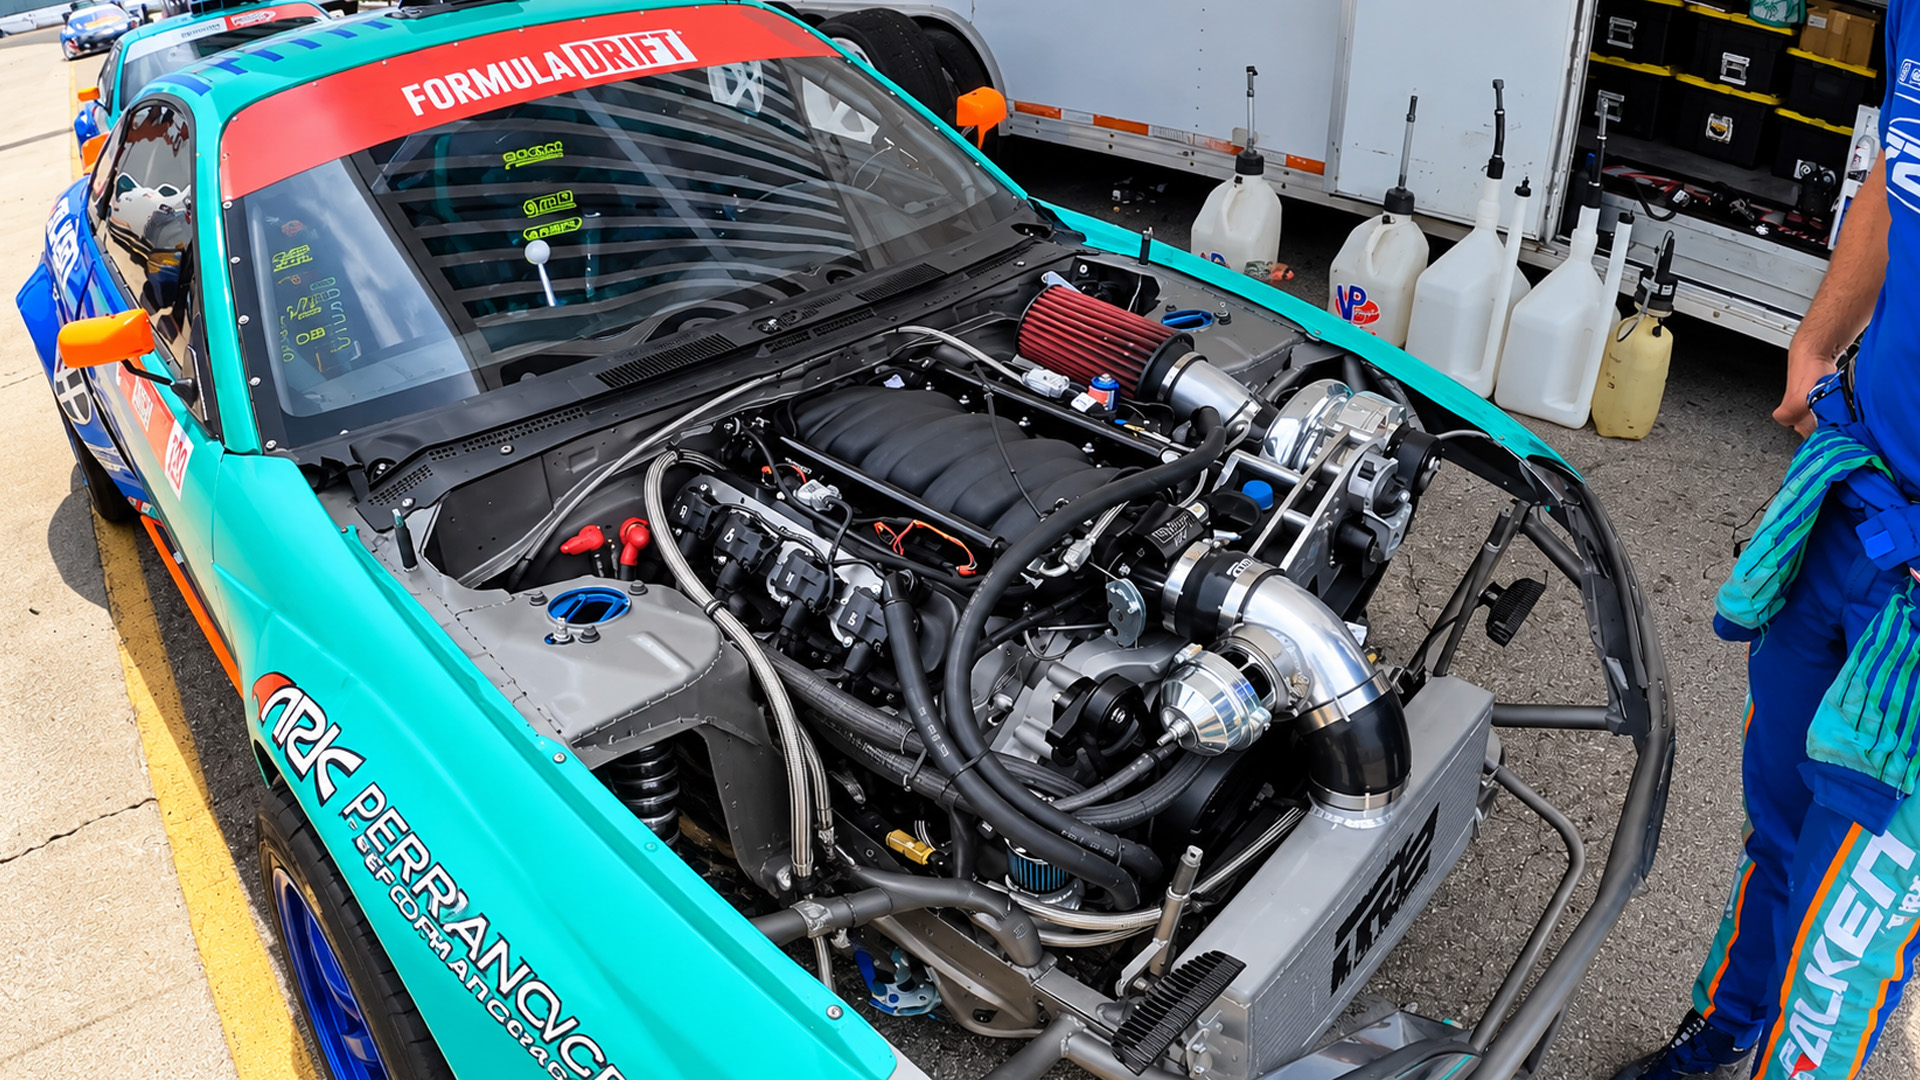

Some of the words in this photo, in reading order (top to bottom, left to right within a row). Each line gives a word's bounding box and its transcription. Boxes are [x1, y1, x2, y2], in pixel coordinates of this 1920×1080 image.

[401, 51, 576, 116] FORMULA
[567, 31, 687, 77] DRIFT
[1336, 284, 1367, 323] VP
